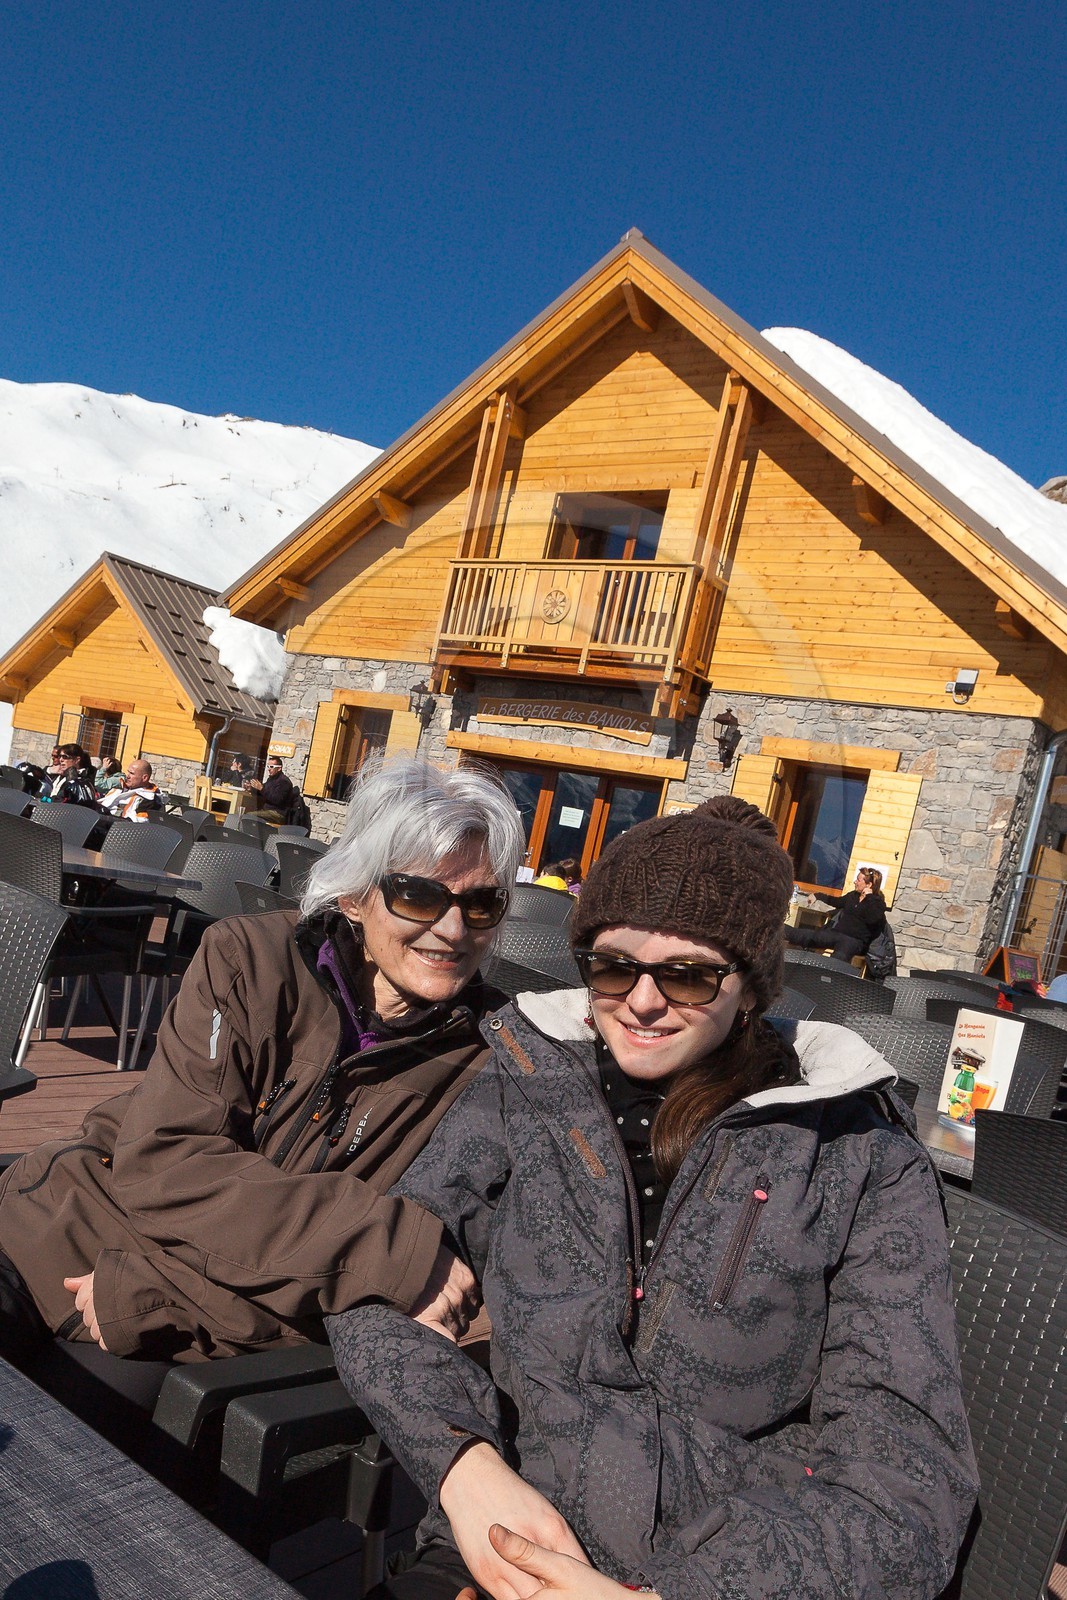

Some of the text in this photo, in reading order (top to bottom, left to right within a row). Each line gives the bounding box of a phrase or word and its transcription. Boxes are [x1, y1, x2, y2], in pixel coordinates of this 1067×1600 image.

[481, 702, 649, 735] La BERGERIE des BANIOLS
[346, 1106, 375, 1156] CEPE
